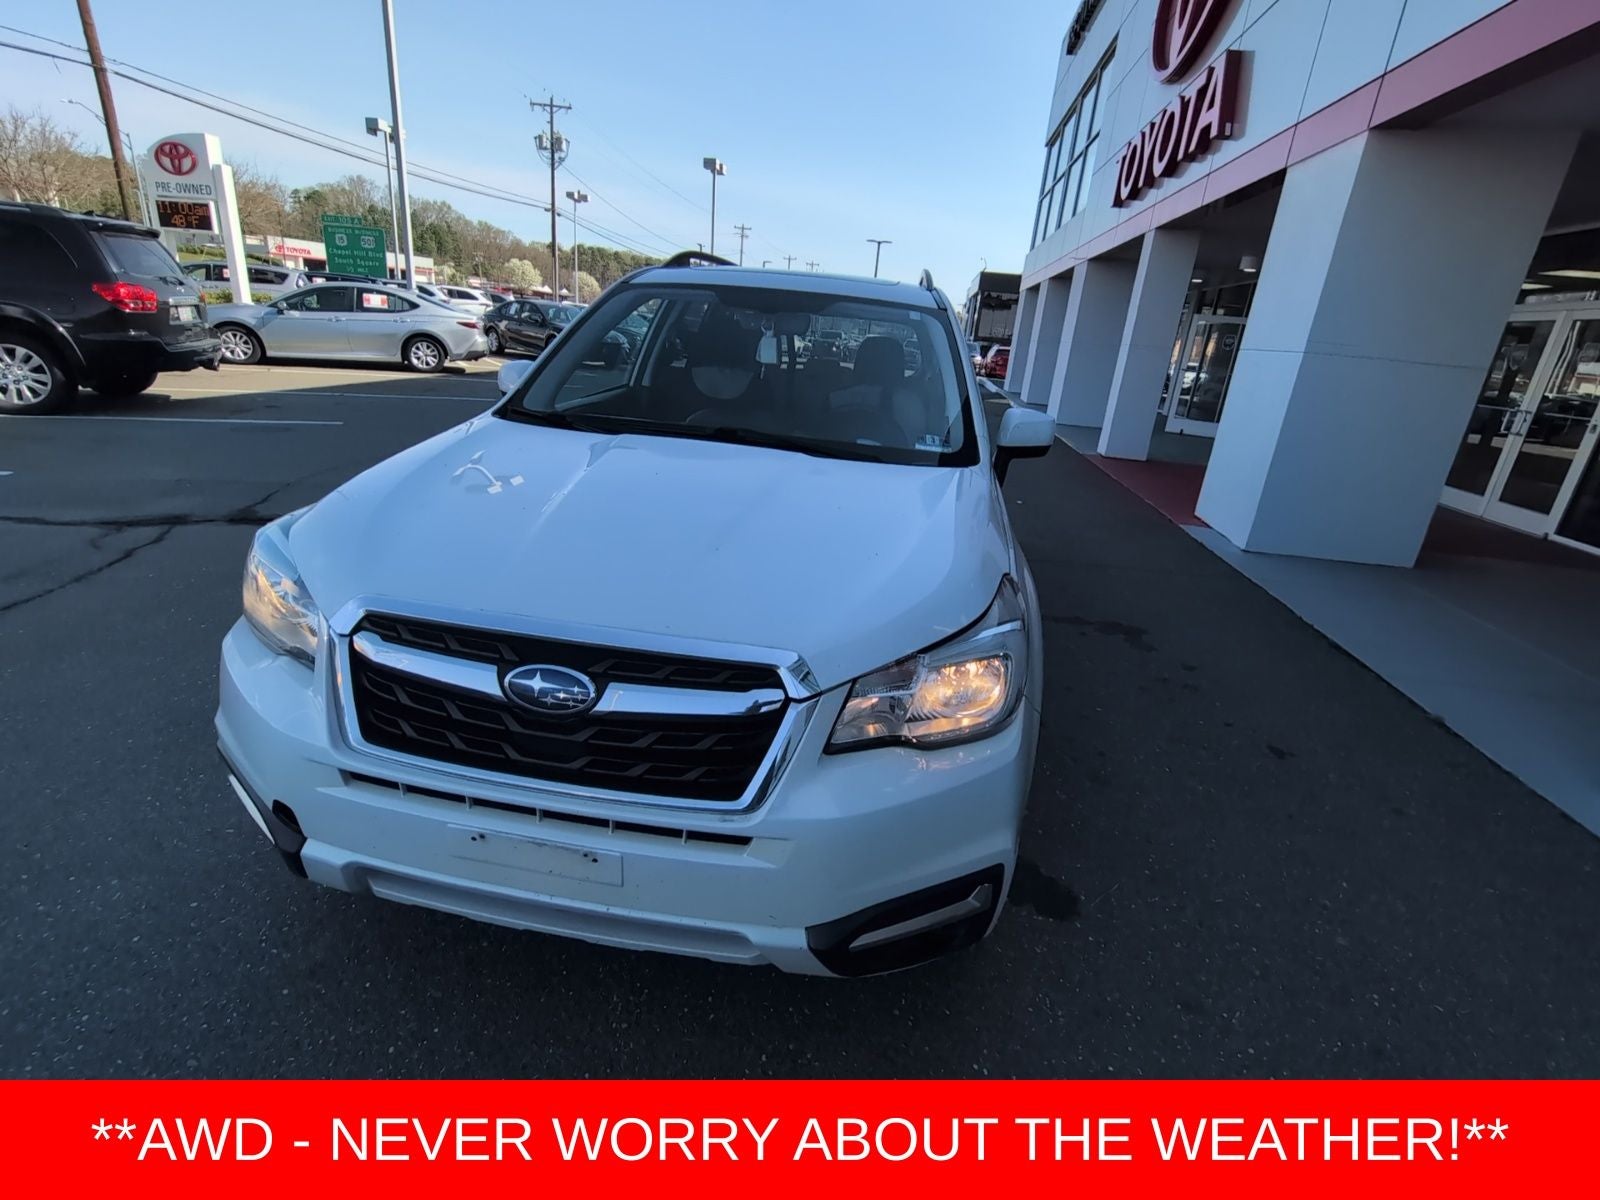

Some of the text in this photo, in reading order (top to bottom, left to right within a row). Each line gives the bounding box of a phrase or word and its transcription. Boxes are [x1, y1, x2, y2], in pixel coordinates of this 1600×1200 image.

[1112, 49, 1240, 207] TOYOTA
[155, 181, 212, 196] PRE-OWNED
[286, 246, 312, 255] TOYOTA
[328, 247, 352, 256] Chapel
[334, 257, 379, 267] South Square
